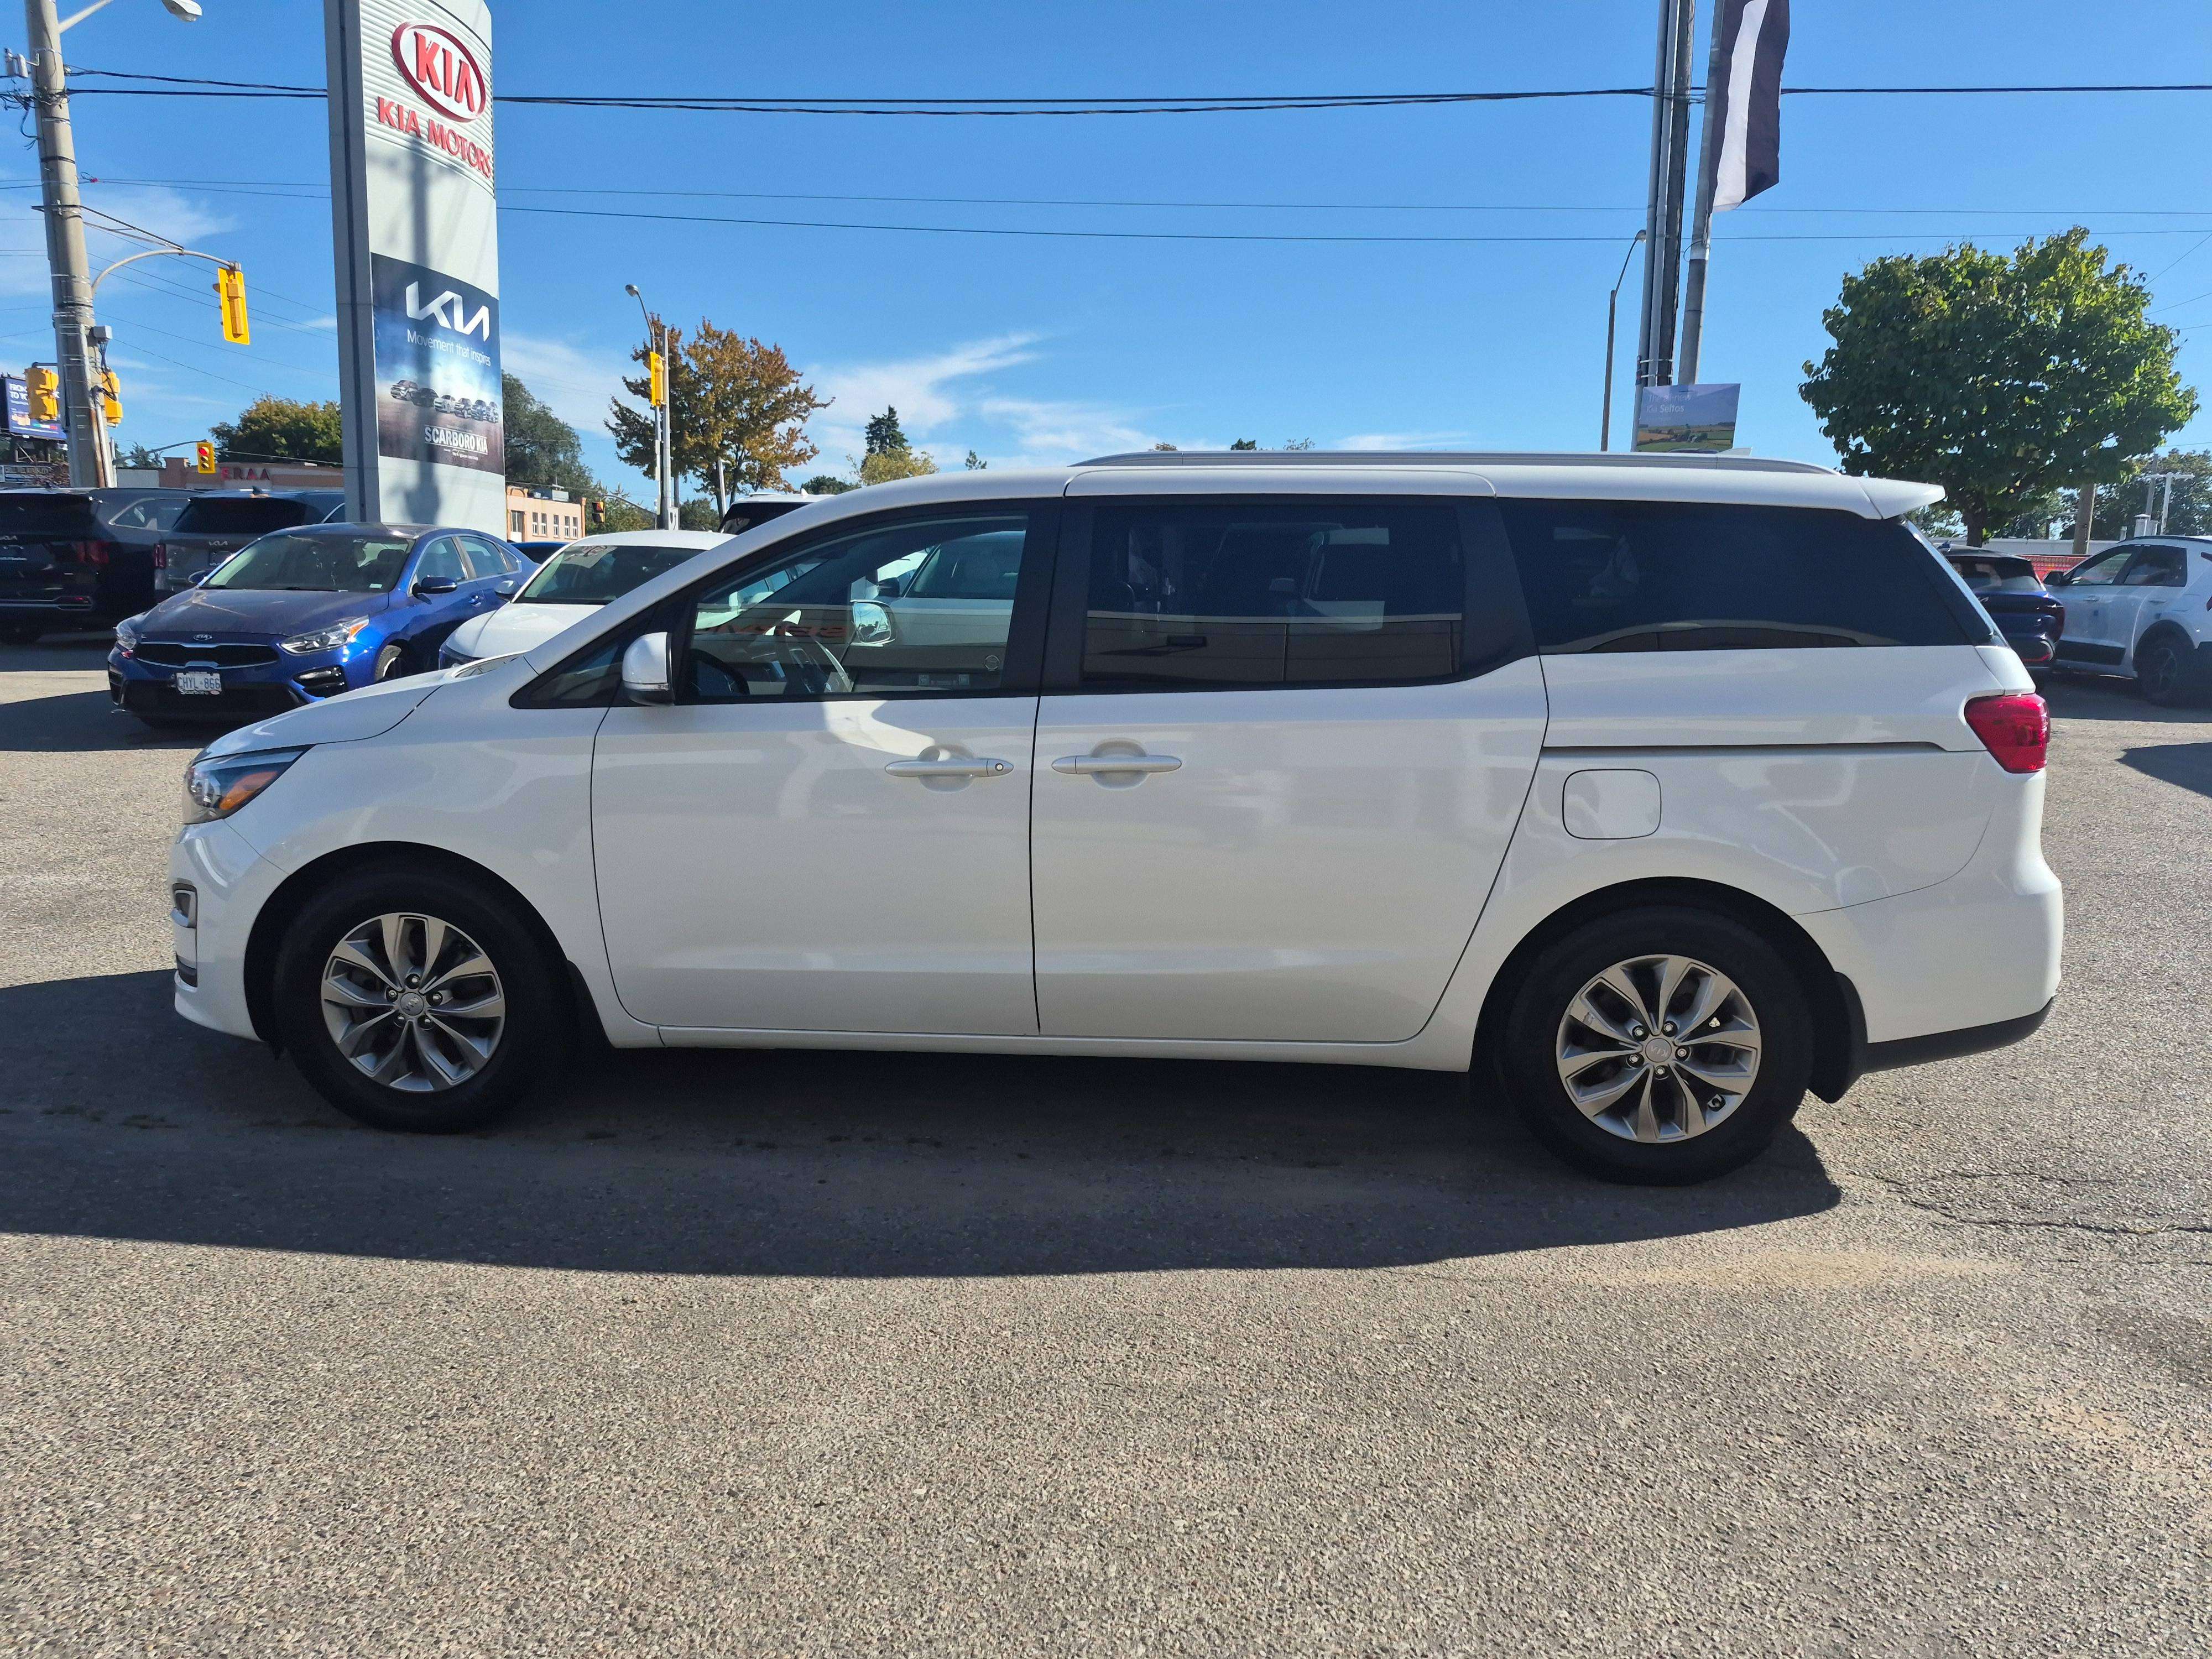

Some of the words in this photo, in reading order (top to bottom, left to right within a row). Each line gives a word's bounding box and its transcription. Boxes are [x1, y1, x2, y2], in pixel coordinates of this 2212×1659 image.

[413, 31, 476, 112] KIA
[378, 96, 421, 138] KIA
[427, 118, 493, 179] MOTORS
[406, 281, 490, 342] KIA
[406, 328, 454, 354] Movement
[456, 342, 470, 358] that
[471, 347, 491, 367] inspires
[1660, 403, 1685, 413] Seltos
[424, 426, 476, 450] SCARBORO
[476, 436, 488, 453] KIA
